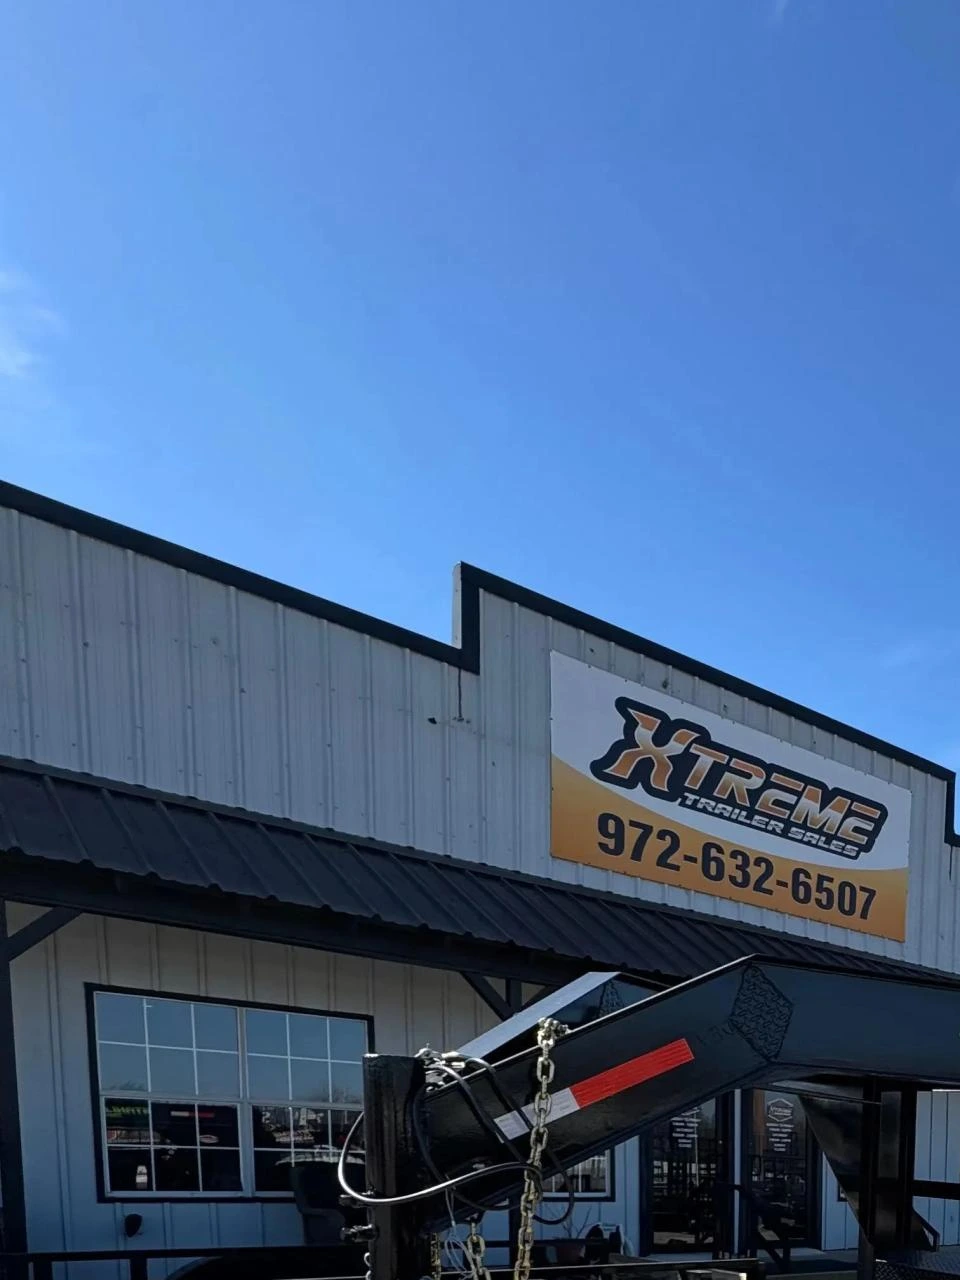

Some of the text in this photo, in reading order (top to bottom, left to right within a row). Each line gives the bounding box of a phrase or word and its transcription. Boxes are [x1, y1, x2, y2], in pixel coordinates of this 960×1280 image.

[601, 706, 881, 846] XTREME
[683, 792, 860, 858] TRAILER SALES
[597, 812, 877, 920] 972-632-6507
